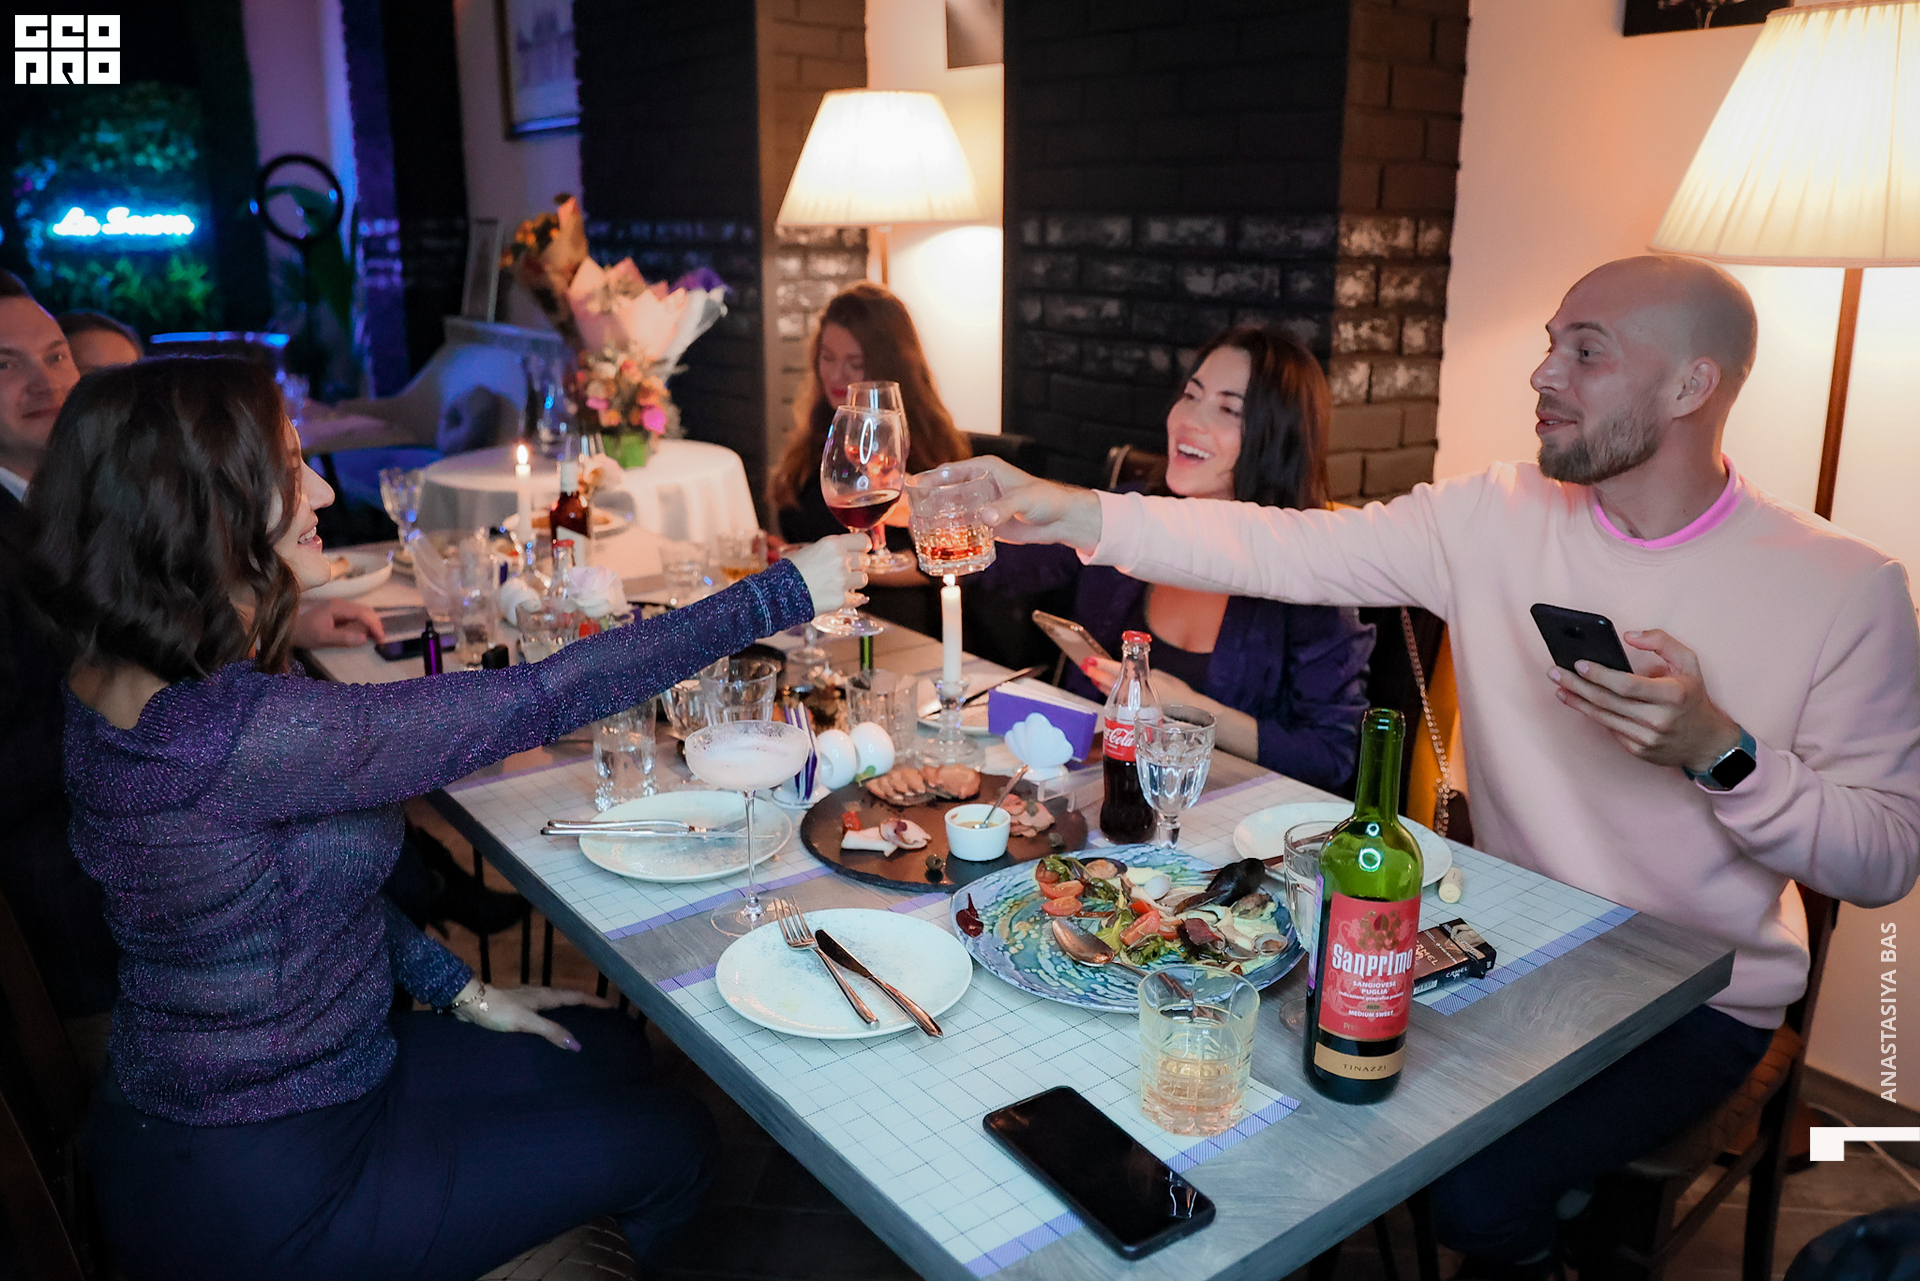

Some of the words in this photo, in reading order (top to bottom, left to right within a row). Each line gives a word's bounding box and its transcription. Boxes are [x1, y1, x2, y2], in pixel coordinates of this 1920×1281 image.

[1332, 943, 1413, 979] Sanprimo
[1445, 966, 1468, 978] CAMEL
[1352, 980, 1397, 989] SANGIOVESE
[1348, 1009, 1375, 1018] MEDIUM
[1375, 1010, 1394, 1018] SWEET
[1343, 1063, 1387, 1072] TINAZZI
